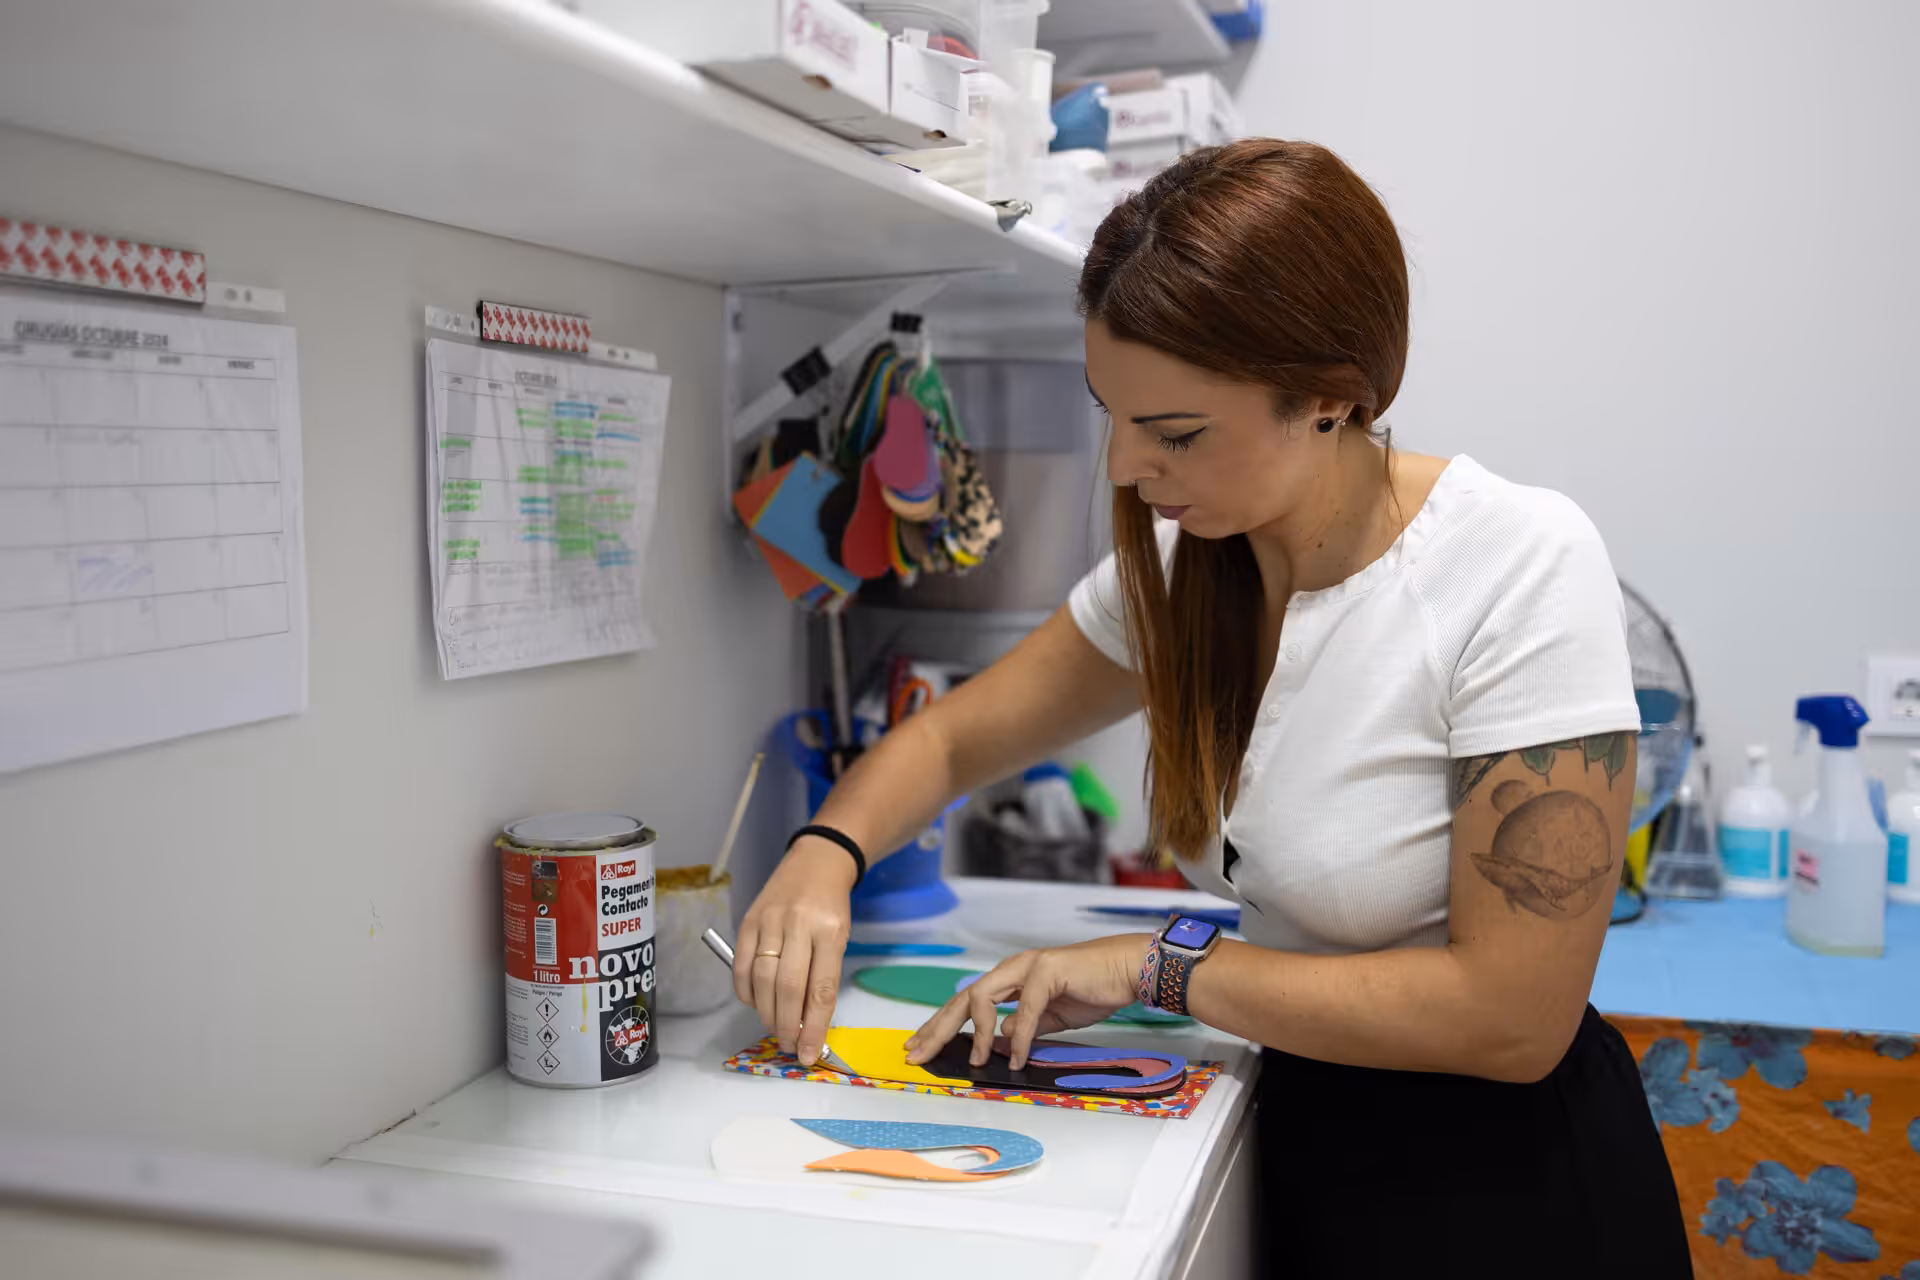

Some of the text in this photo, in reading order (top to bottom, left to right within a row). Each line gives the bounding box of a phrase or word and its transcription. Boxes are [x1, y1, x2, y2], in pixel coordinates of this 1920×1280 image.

[617, 863, 634, 875] Rayt
[602, 895, 648, 916] Contacto
[602, 917, 641, 937] SUPER
[569, 943, 654, 979] novo
[540, 970, 560, 983] litro
